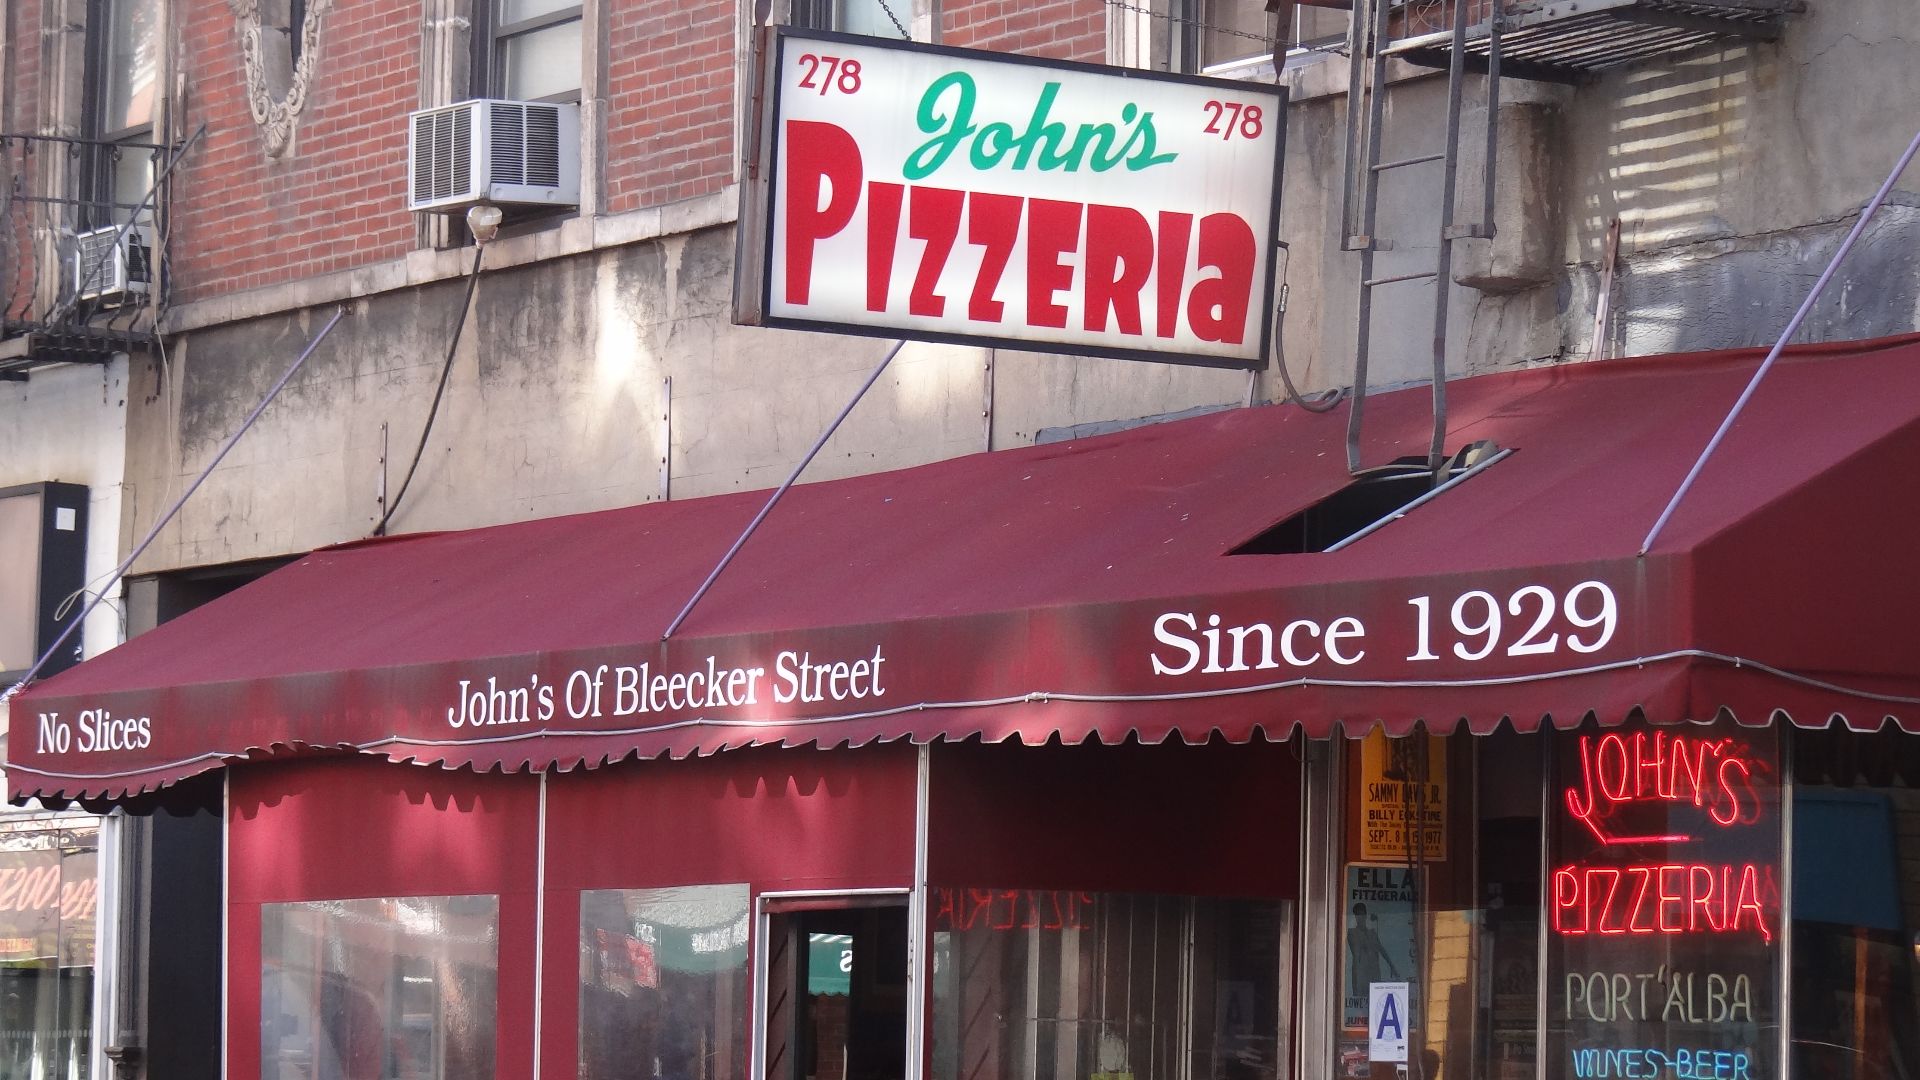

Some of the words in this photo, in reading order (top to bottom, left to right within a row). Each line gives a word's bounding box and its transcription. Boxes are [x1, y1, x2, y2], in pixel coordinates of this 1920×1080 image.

[798, 53, 862, 96] 278
[902, 71, 1180, 181] John's
[1203, 100, 1263, 141] 278
[1150, 612, 1366, 676] Since
[1406, 580, 1618, 662] 1929
[448, 674, 554, 728] John's
[565, 664, 608, 719] Of
[613, 656, 765, 717] Bleecker
[773, 644, 886, 704] Street
[37, 712, 71, 754] No
[77, 708, 151, 752] Slices
[1368, 783, 1399, 802] SAMMY
[1402, 783, 1426, 804] DAVS
[1566, 730, 1750, 844] JOHN'S
[1368, 809, 1395, 820] BILLY
[1399, 809, 1441, 821] EKTINE
[1368, 829, 1392, 843] SEPT.
[1425, 831, 1442, 844] 1977
[1352, 889, 1418, 901] FITZGERAL
[1357, 868, 1416, 888] ELLA
[1555, 864, 1771, 944] PIZZERIA
[1376, 992, 1403, 1039] A
